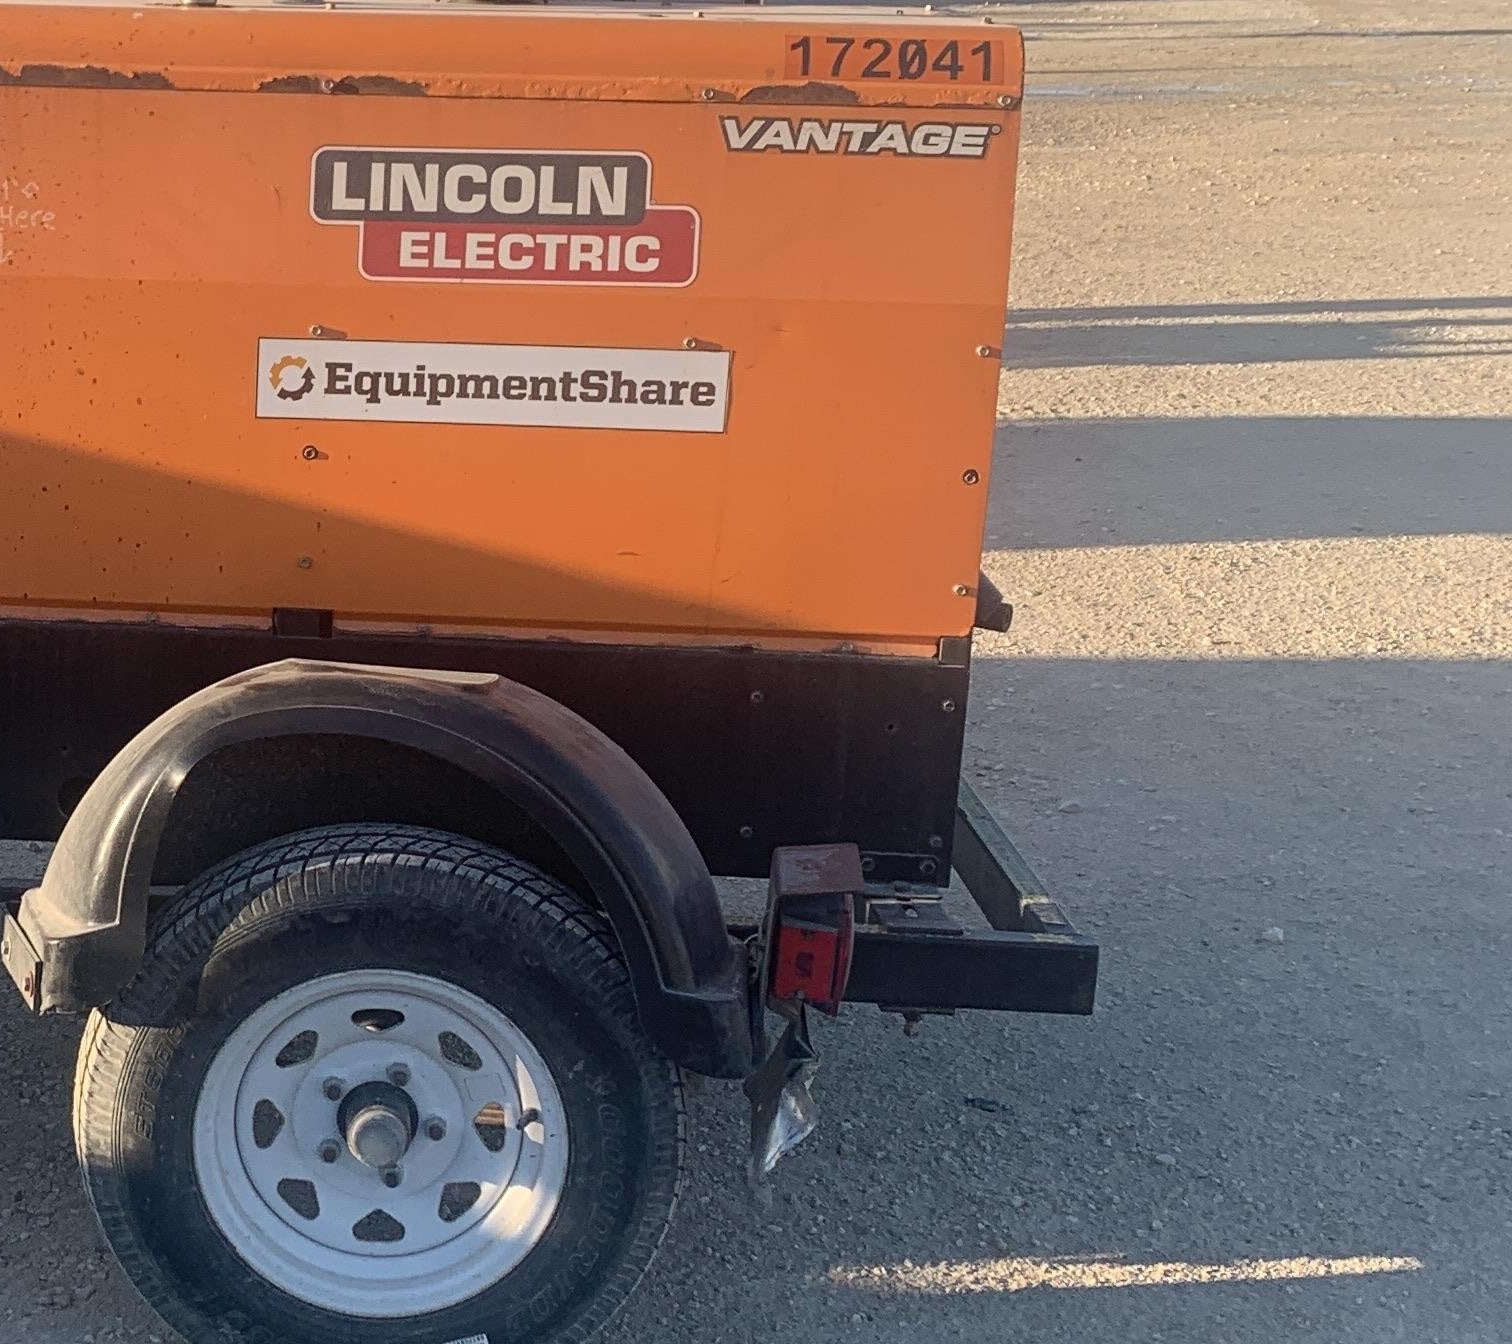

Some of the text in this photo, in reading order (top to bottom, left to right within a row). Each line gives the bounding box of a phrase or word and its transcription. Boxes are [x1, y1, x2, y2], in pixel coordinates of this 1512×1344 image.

[790, 35, 993, 82] 172041
[720, 117, 992, 157] VANTAGE
[331, 160, 629, 217] LINCOLN
[0, 205, 56, 231] Here
[398, 230, 662, 274] ELECTRIC
[323, 361, 717, 408] EquipmentShare
